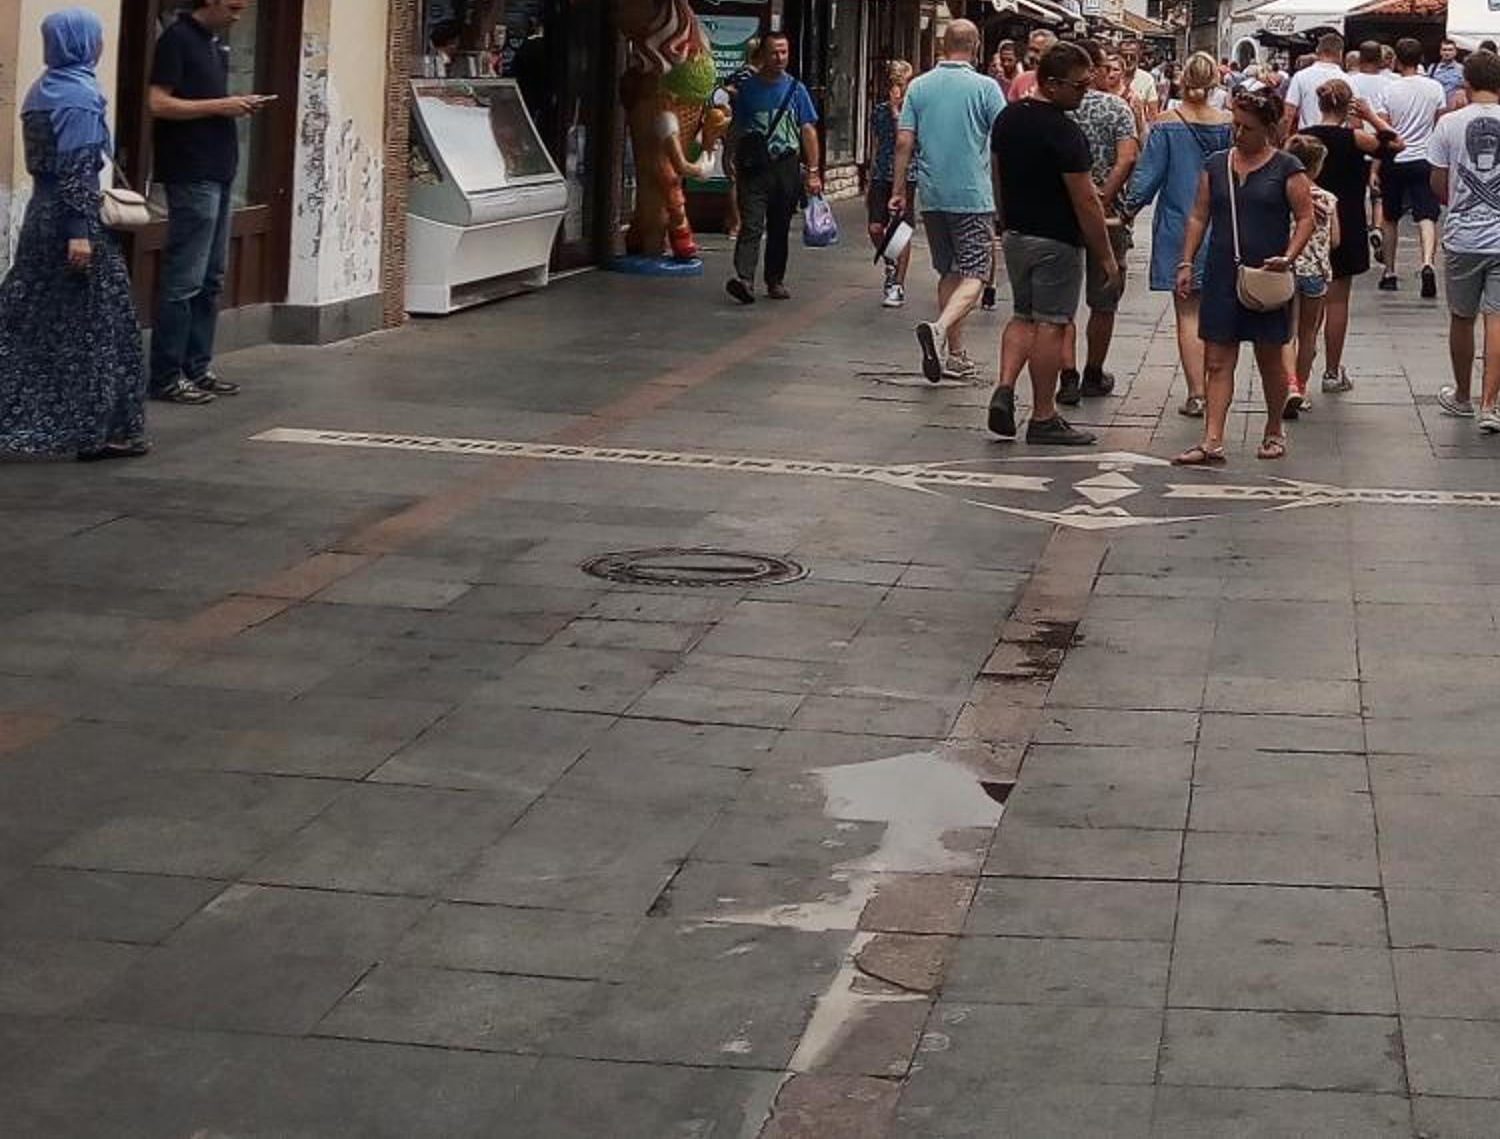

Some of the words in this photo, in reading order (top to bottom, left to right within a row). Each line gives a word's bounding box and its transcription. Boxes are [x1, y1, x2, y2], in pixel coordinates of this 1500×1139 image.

[593, 451, 770, 468] MEETING
[785, 463, 994, 484] SARAJEVO
[1223, 487, 1439, 500] SARAJEVO
